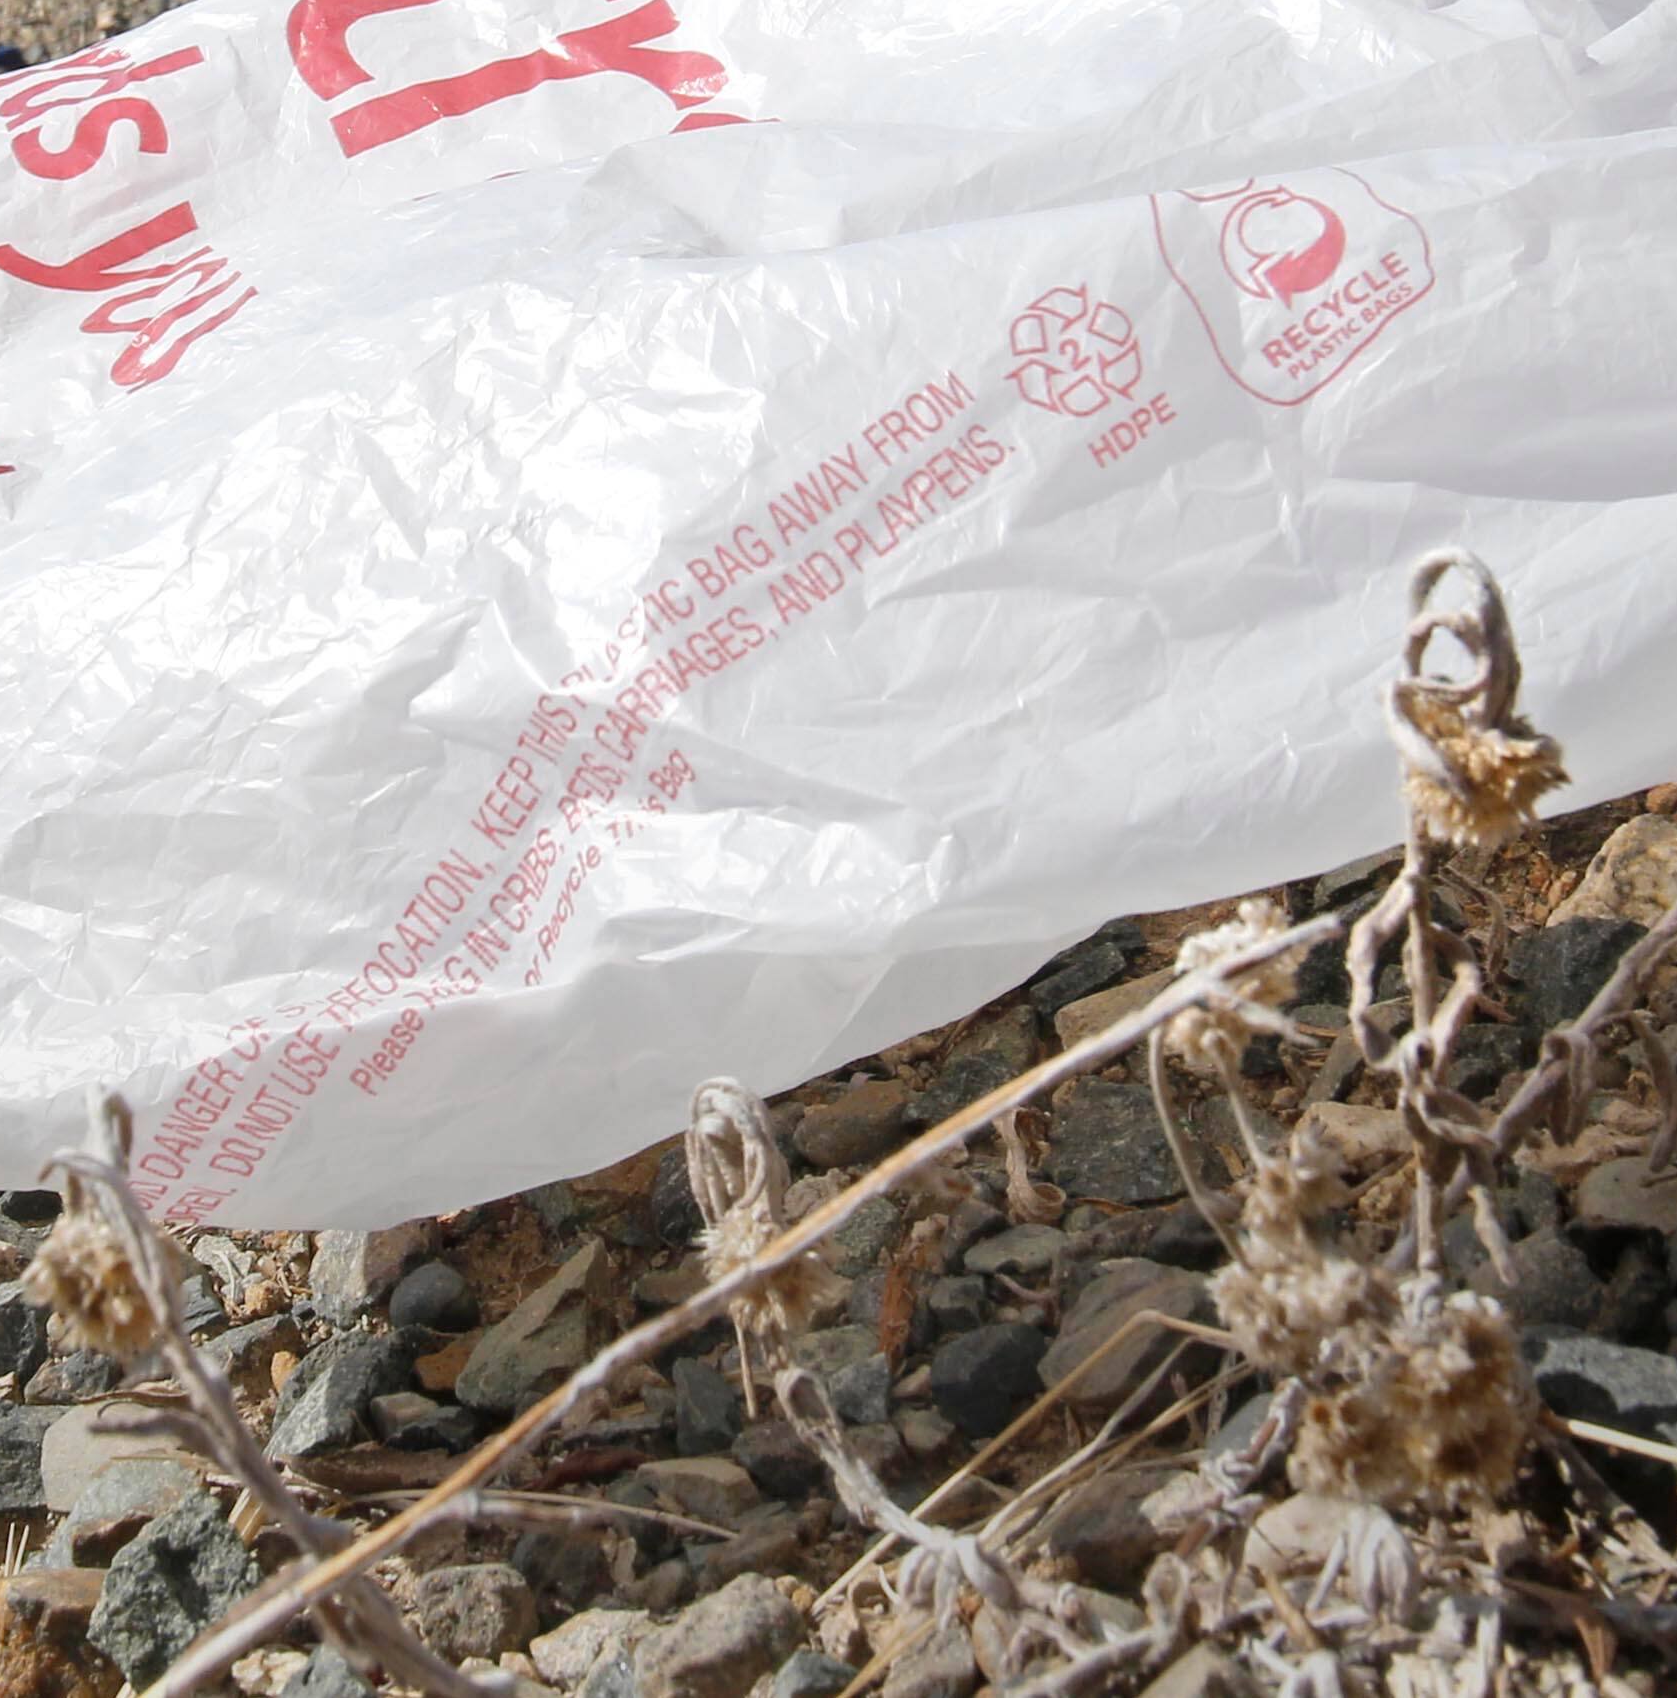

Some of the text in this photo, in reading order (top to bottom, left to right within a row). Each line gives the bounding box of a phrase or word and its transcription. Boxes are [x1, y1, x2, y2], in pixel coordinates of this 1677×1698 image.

[1261, 252, 1409, 368] RECYCLE
[1287, 282, 1414, 380] PLASTIC BAGS
[1058, 338, 1092, 371] 2
[1087, 391, 1177, 468] HDPE
[834, 423, 1017, 573] PLAYPENS.
[767, 551, 845, 626] AND
[594, 606, 779, 762] CARRIAGES,
[138, 1056, 244, 1180] DANGER
[471, 755, 542, 850] KEEP
[517, 693, 577, 766] THIS
[686, 523, 775, 599] BAG
[767, 442, 869, 547] AWAY
[862, 370, 975, 467] FROM
[349, 1007, 425, 1096] Please
[537, 845, 601, 963] Recycle
[648, 749, 696, 801] Bag
[489, 827, 565, 934] CRIBS,
[462, 918, 511, 972] IN
[270, 1021, 341, 1097] USE
[233, 1083, 301, 1141] NOT
[208, 1137, 266, 1177] DO
